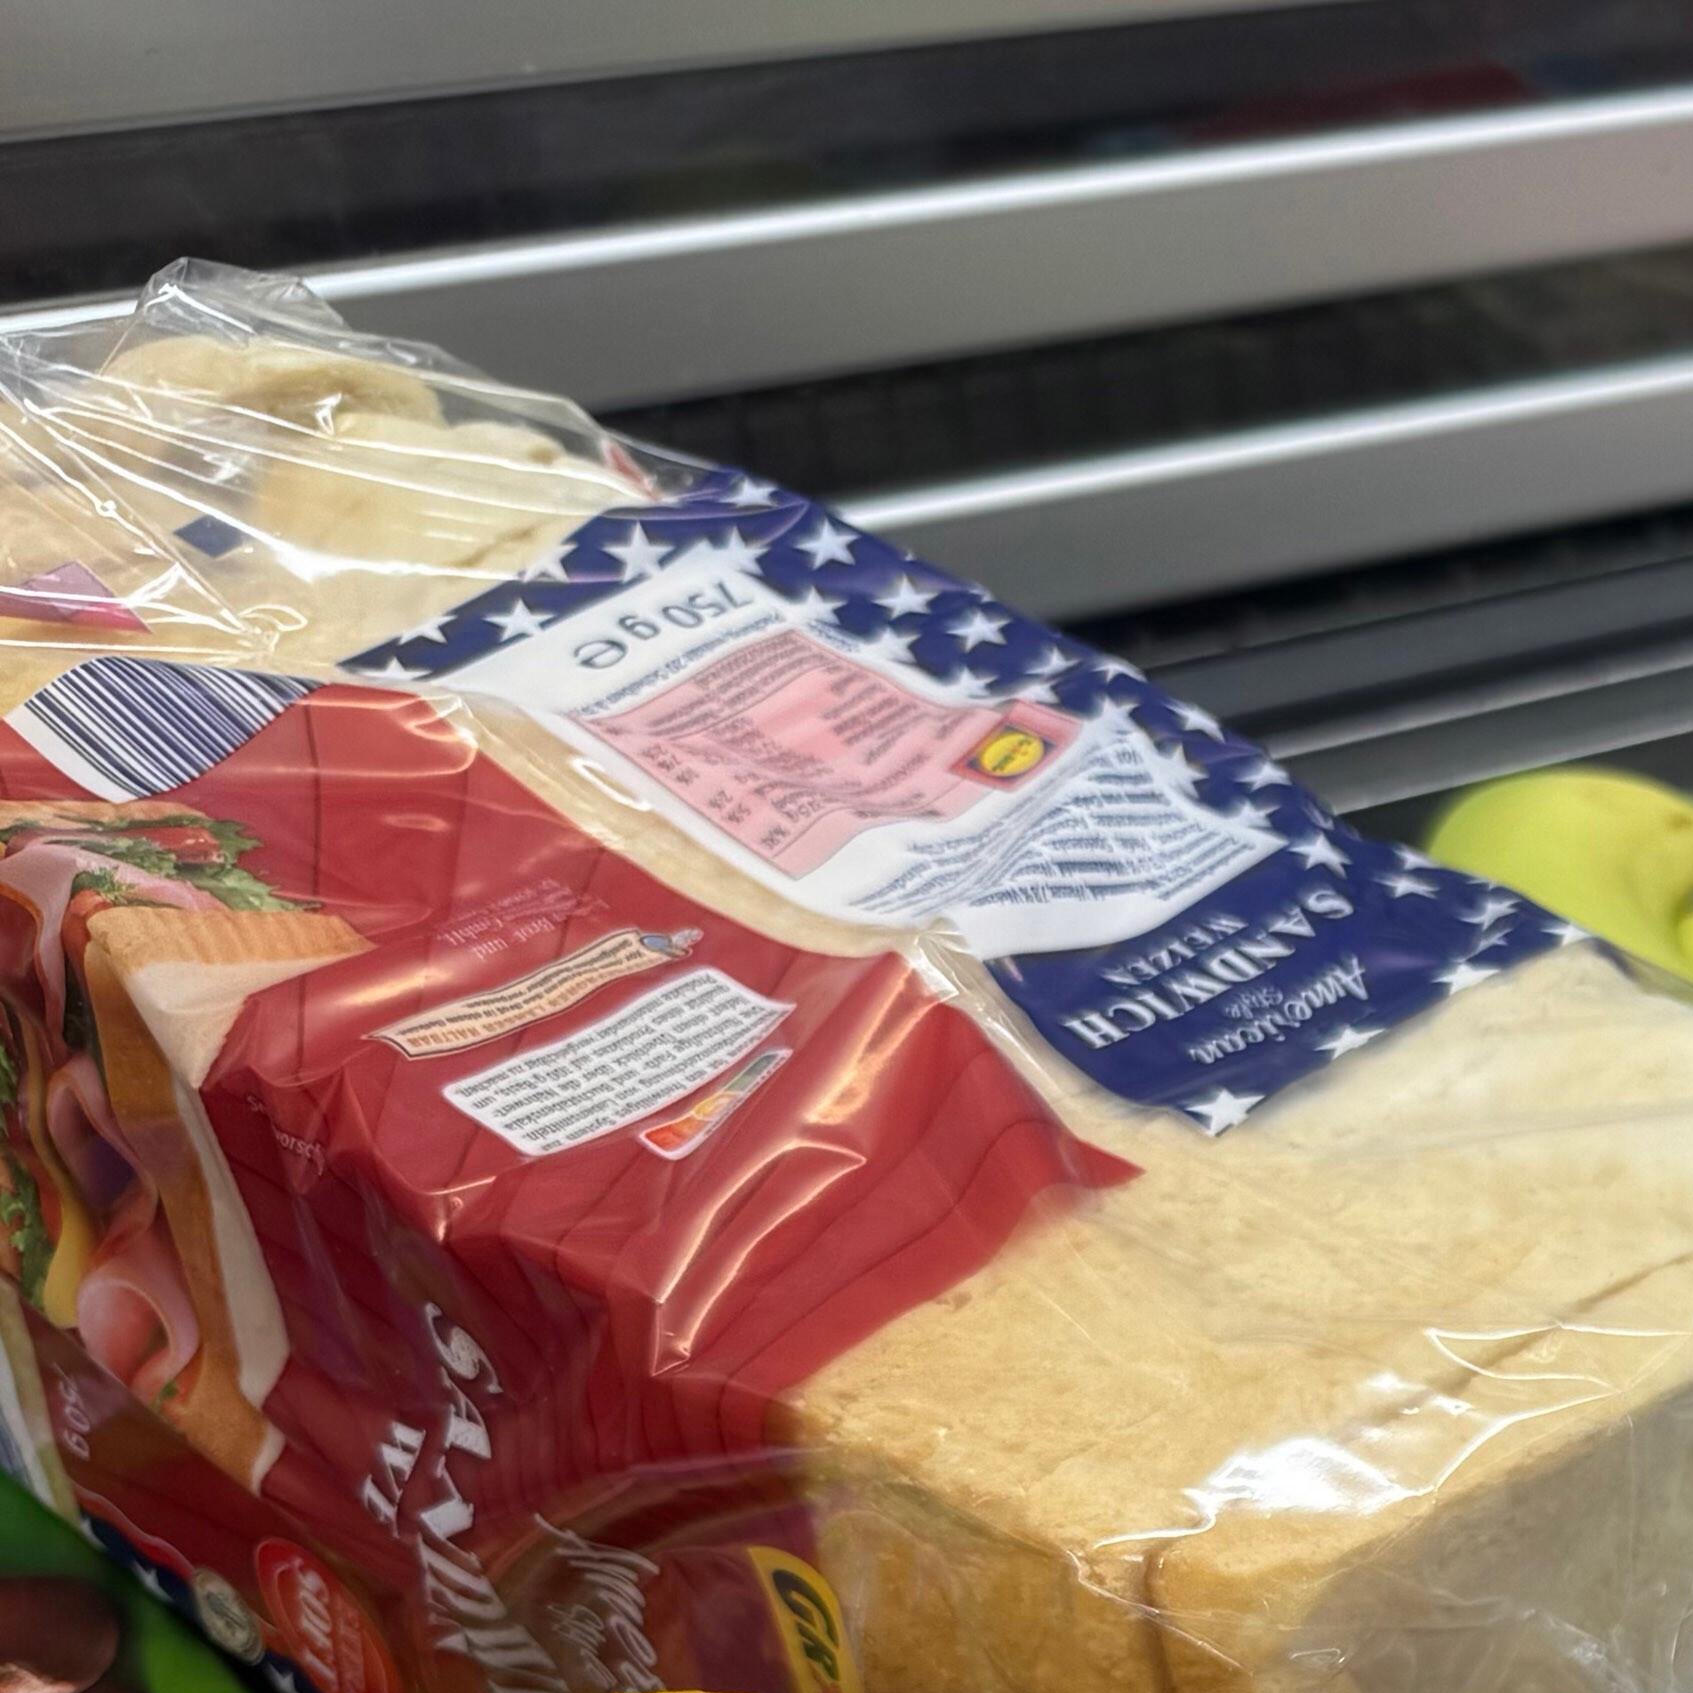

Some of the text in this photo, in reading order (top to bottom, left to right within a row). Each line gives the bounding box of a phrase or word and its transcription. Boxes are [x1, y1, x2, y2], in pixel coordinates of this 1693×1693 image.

[617, 613, 659, 643] g
[660, 580, 752, 632] 750
[471, 938, 507, 959] und
[1061, 887, 1355, 1052] SANDWICH
[1099, 912, 1246, 990] WEIZEN
[1187, 956, 1367, 1069] American
